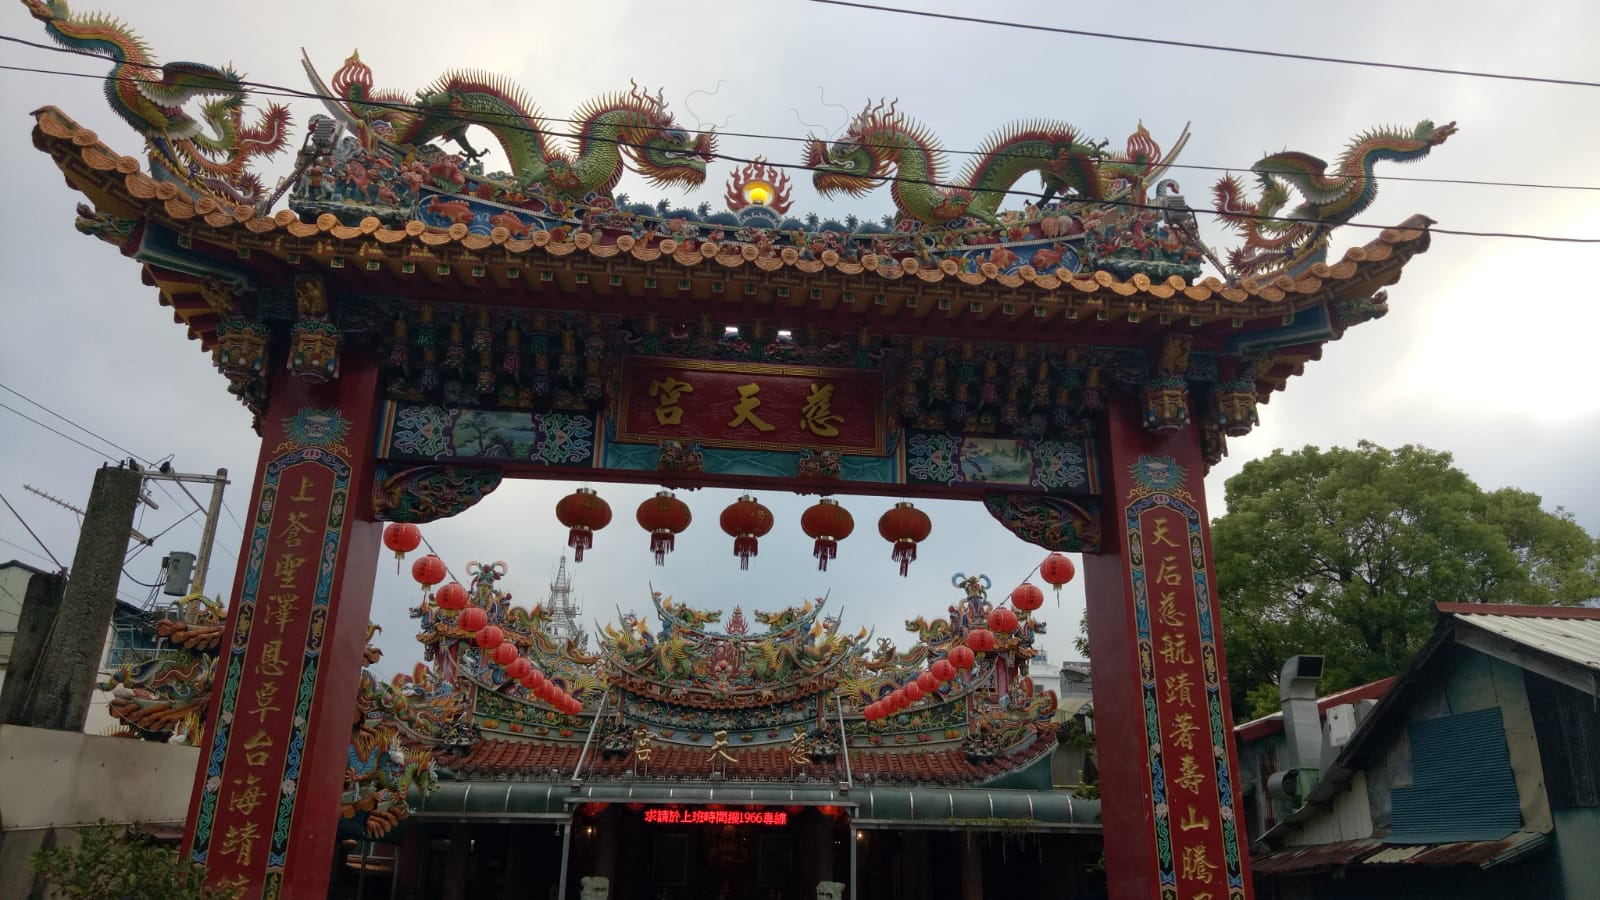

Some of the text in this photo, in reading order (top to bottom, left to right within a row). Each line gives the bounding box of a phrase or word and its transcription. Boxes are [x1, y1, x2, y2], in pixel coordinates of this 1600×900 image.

[649, 376, 844, 437] 慈天宮
[1151, 517, 1218, 899] 天后慈航蹟著壽山騰
